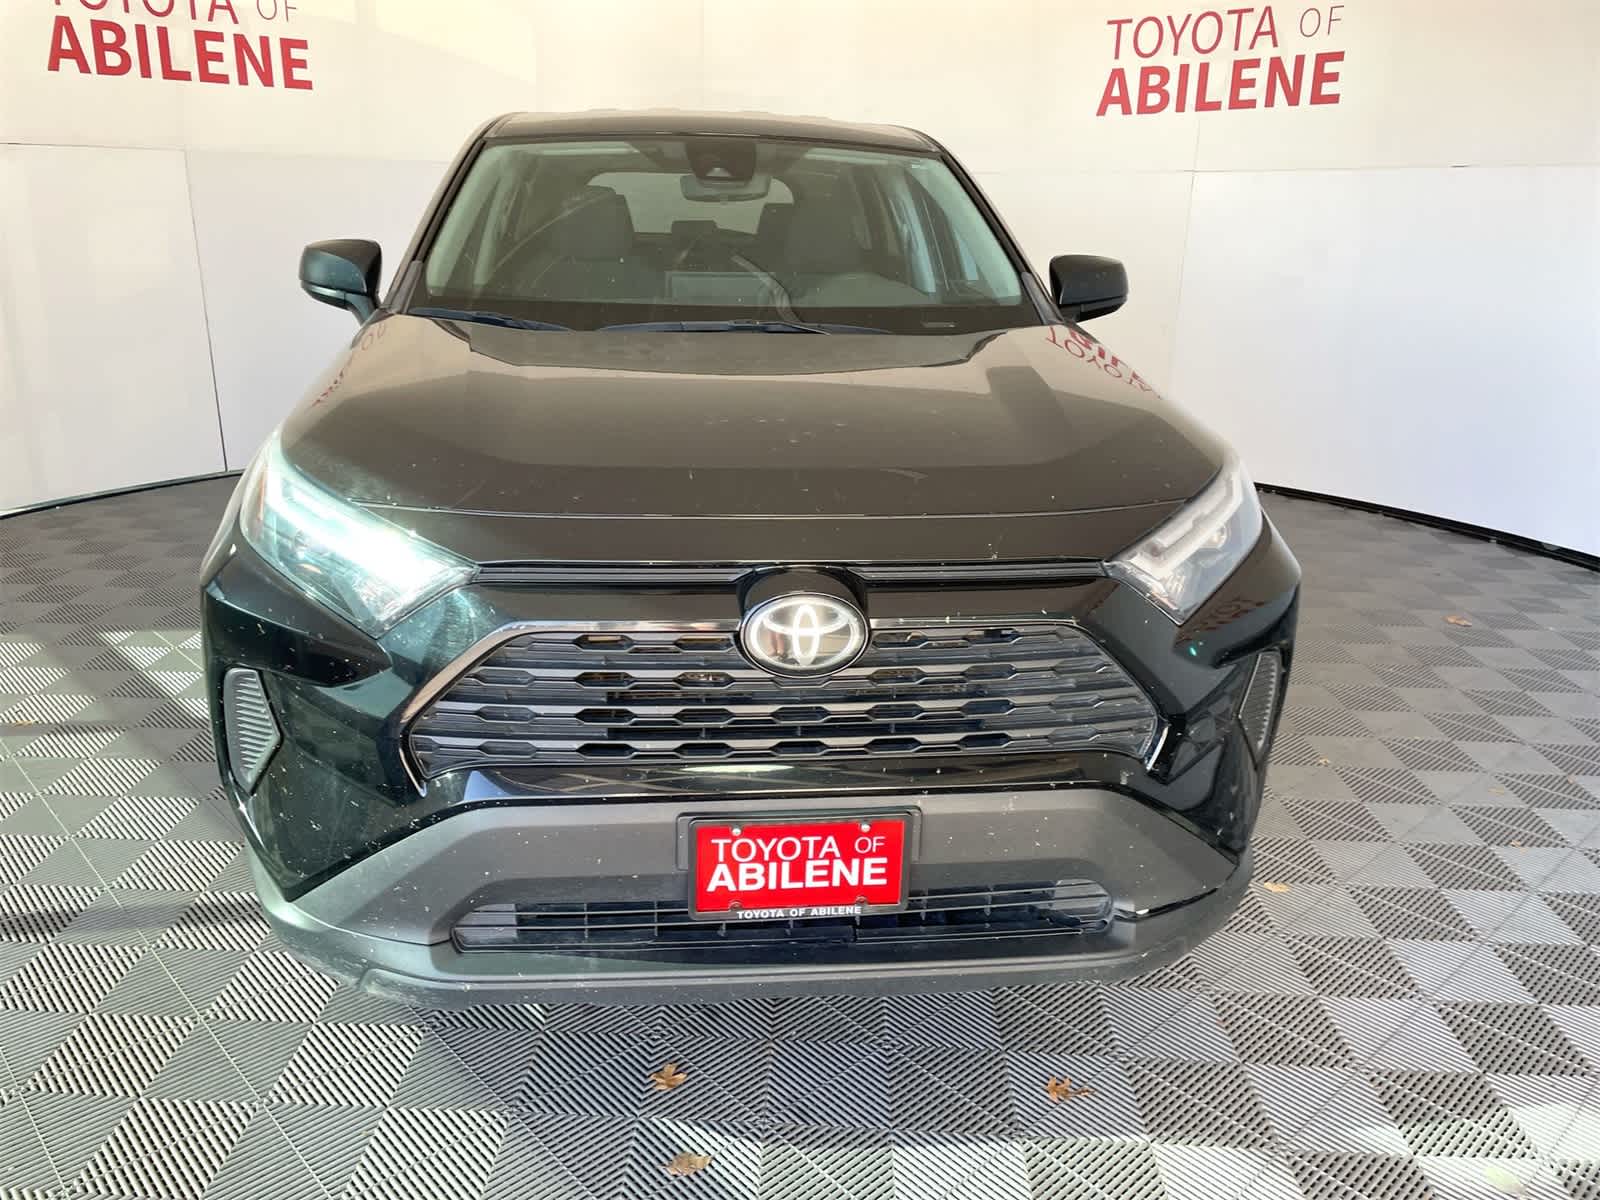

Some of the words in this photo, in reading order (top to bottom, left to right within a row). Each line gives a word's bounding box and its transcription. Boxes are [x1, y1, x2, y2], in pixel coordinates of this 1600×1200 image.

[48, 15, 313, 90] ABILENE
[1107, 6, 1279, 60] TOYOTA
[1300, 5, 1345, 37] OF
[1096, 51, 1345, 117] ABILENE
[711, 835, 841, 863] TOYOTA
[854, 836, 886, 854] OF
[706, 857, 888, 892] ABILENE
[736, 909, 785, 920] TOYOTA
[789, 908, 805, 918] OF
[810, 906, 862, 917] ABILENE
